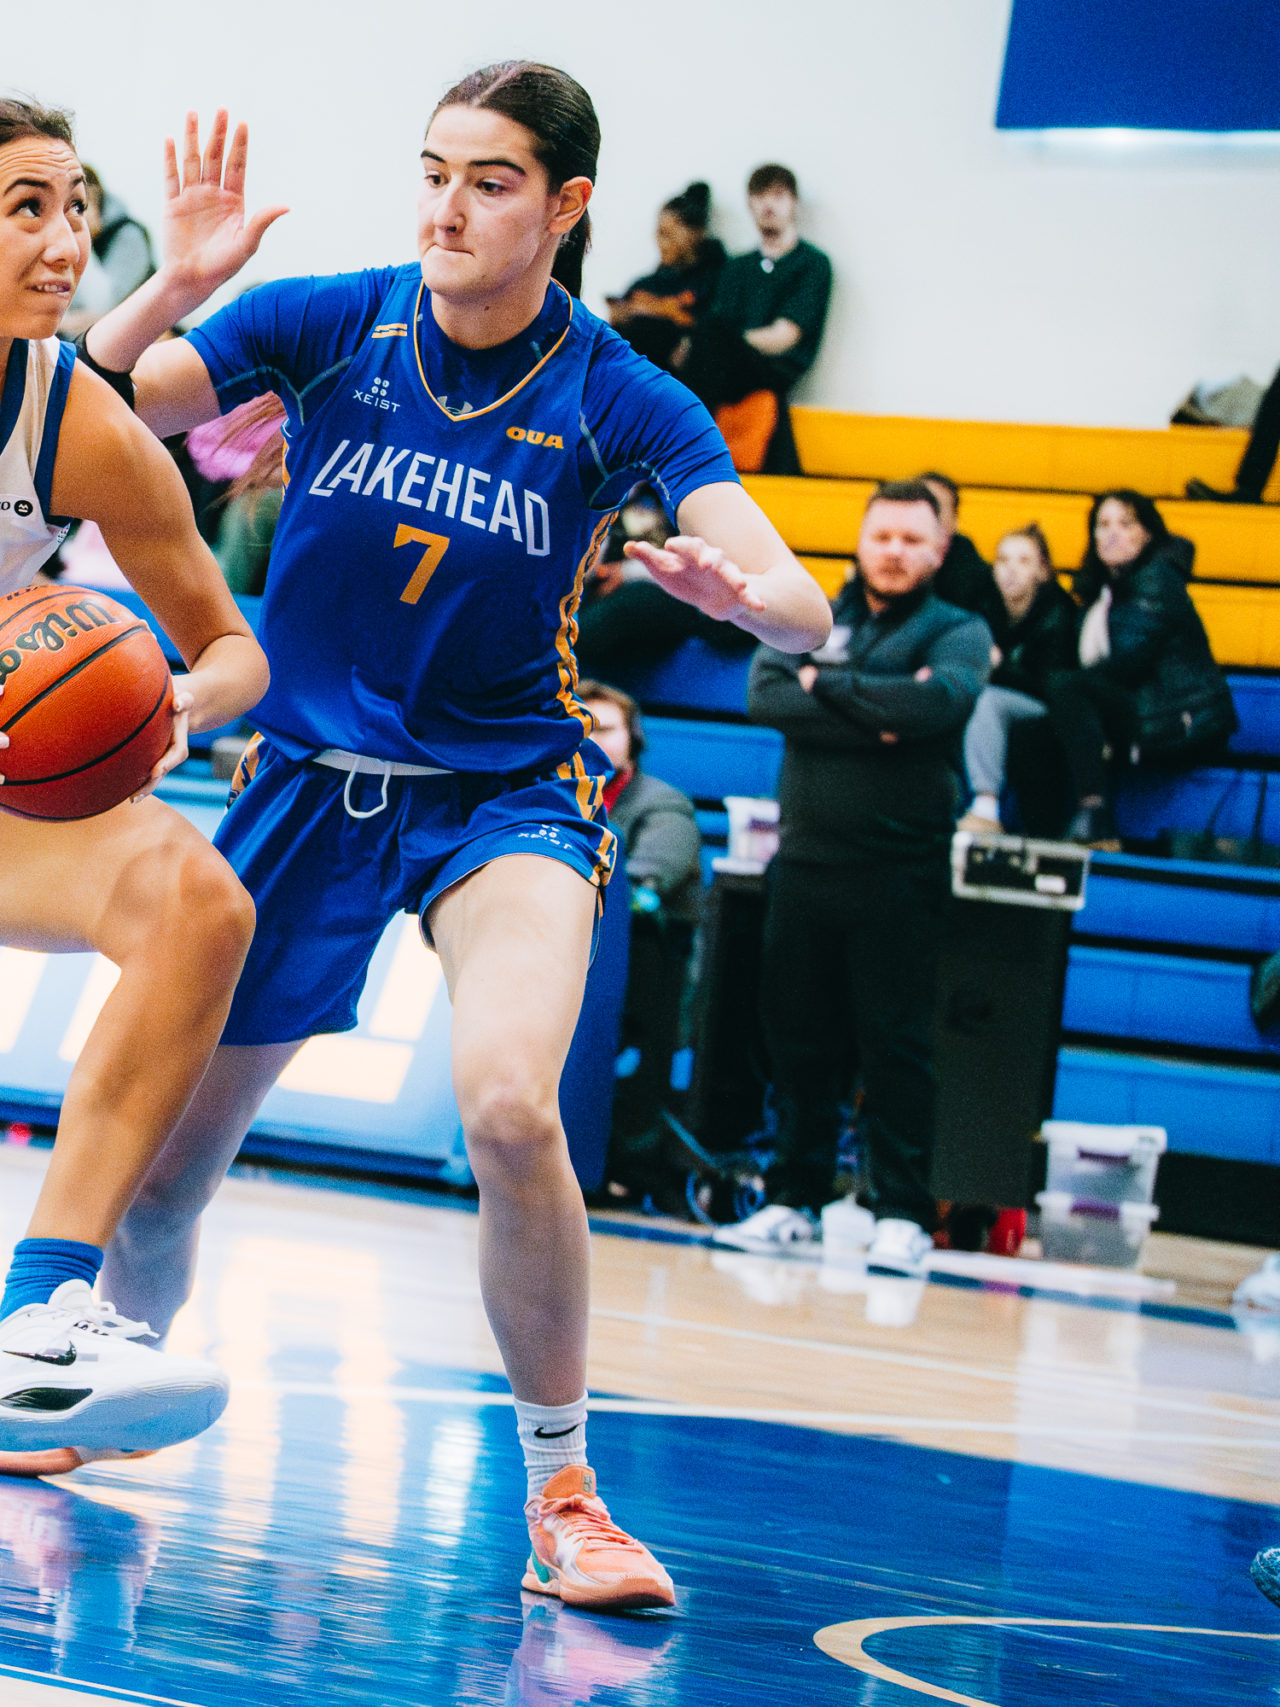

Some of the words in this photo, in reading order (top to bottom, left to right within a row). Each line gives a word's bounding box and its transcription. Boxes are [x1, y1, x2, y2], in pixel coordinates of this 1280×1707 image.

[352, 389, 400, 413] XEIST
[506, 426, 564, 449] OUA
[308, 439, 551, 557] LAKEHEAD
[393, 523, 451, 605] 7
